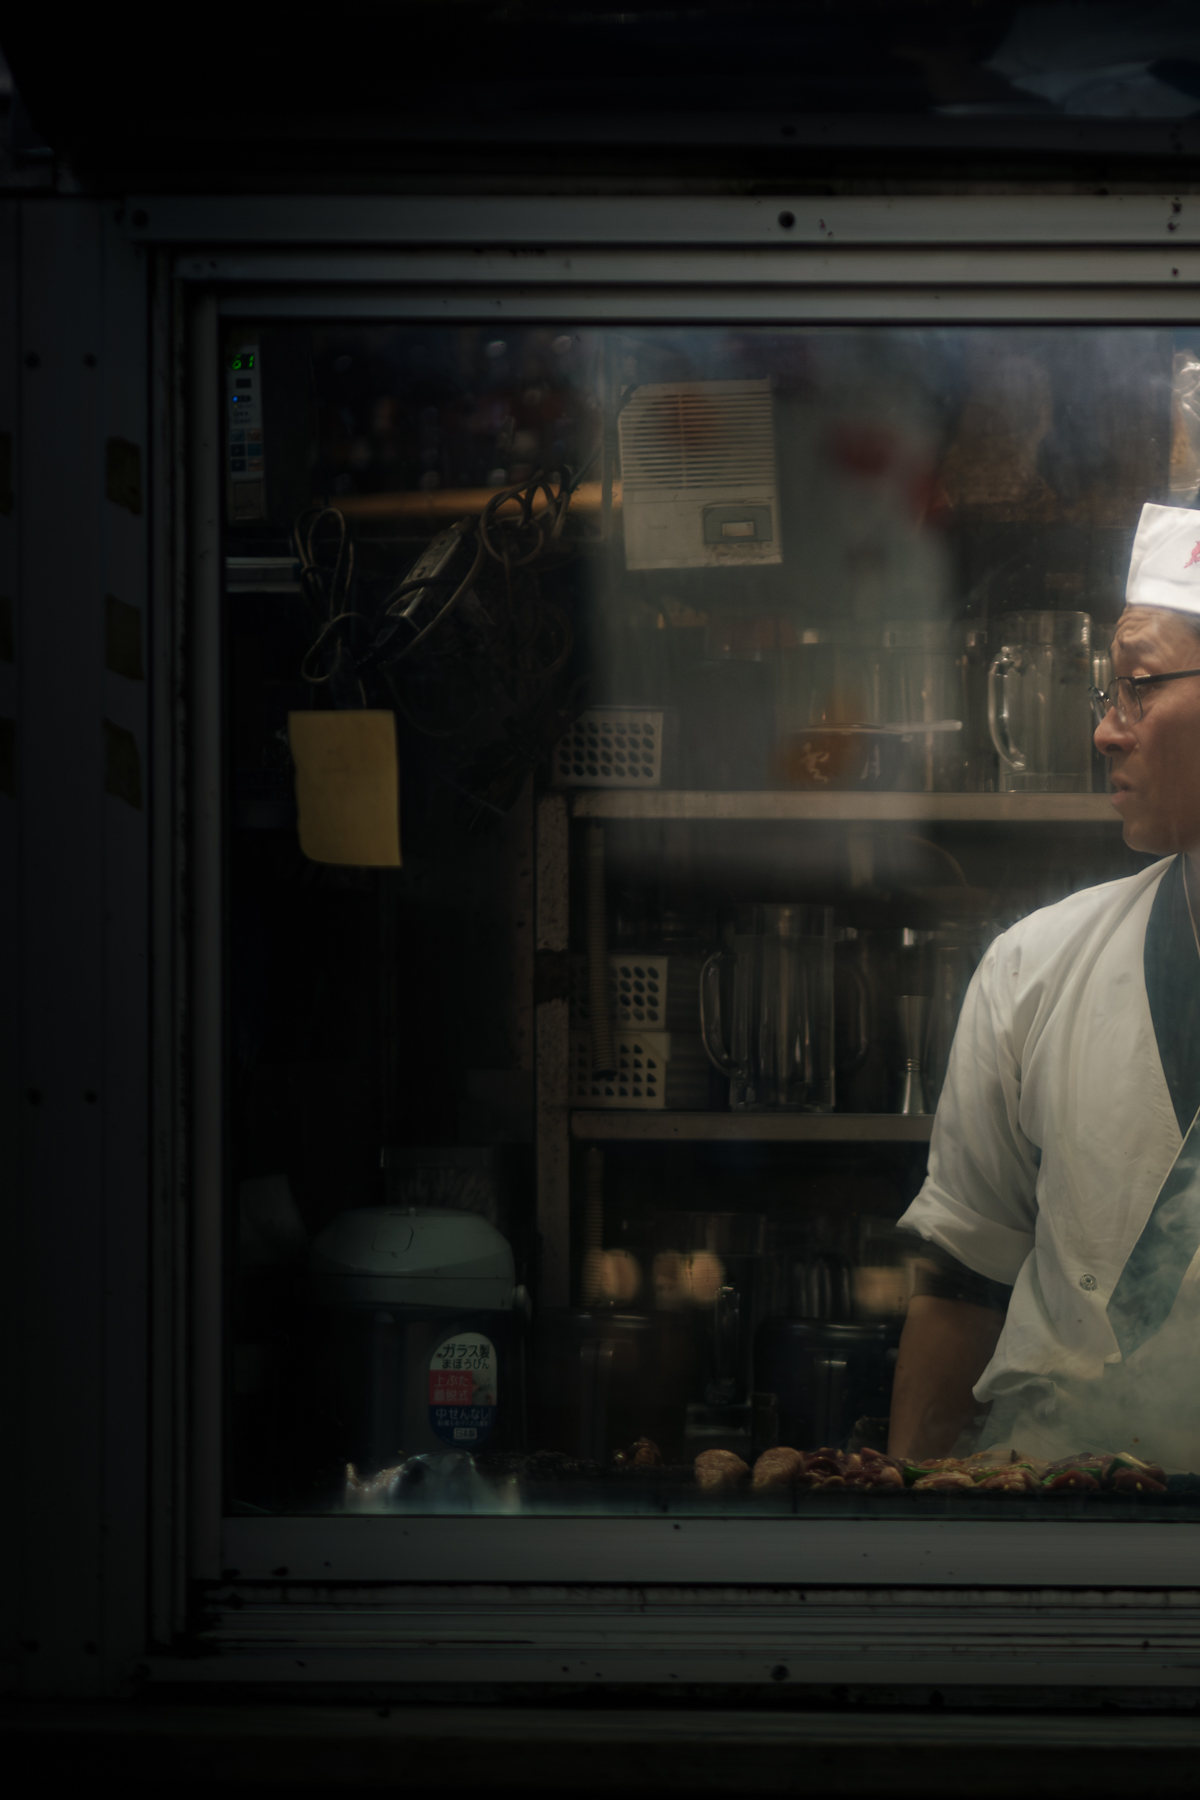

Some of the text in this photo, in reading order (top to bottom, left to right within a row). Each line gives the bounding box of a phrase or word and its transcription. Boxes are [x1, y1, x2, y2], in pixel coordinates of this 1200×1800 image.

[231, 353, 254, 370] 61
[442, 1344, 490, 1358] ガラス製
[442, 1358, 490, 1370] まほうびん
[433, 1374, 469, 1387] 上ぶた
